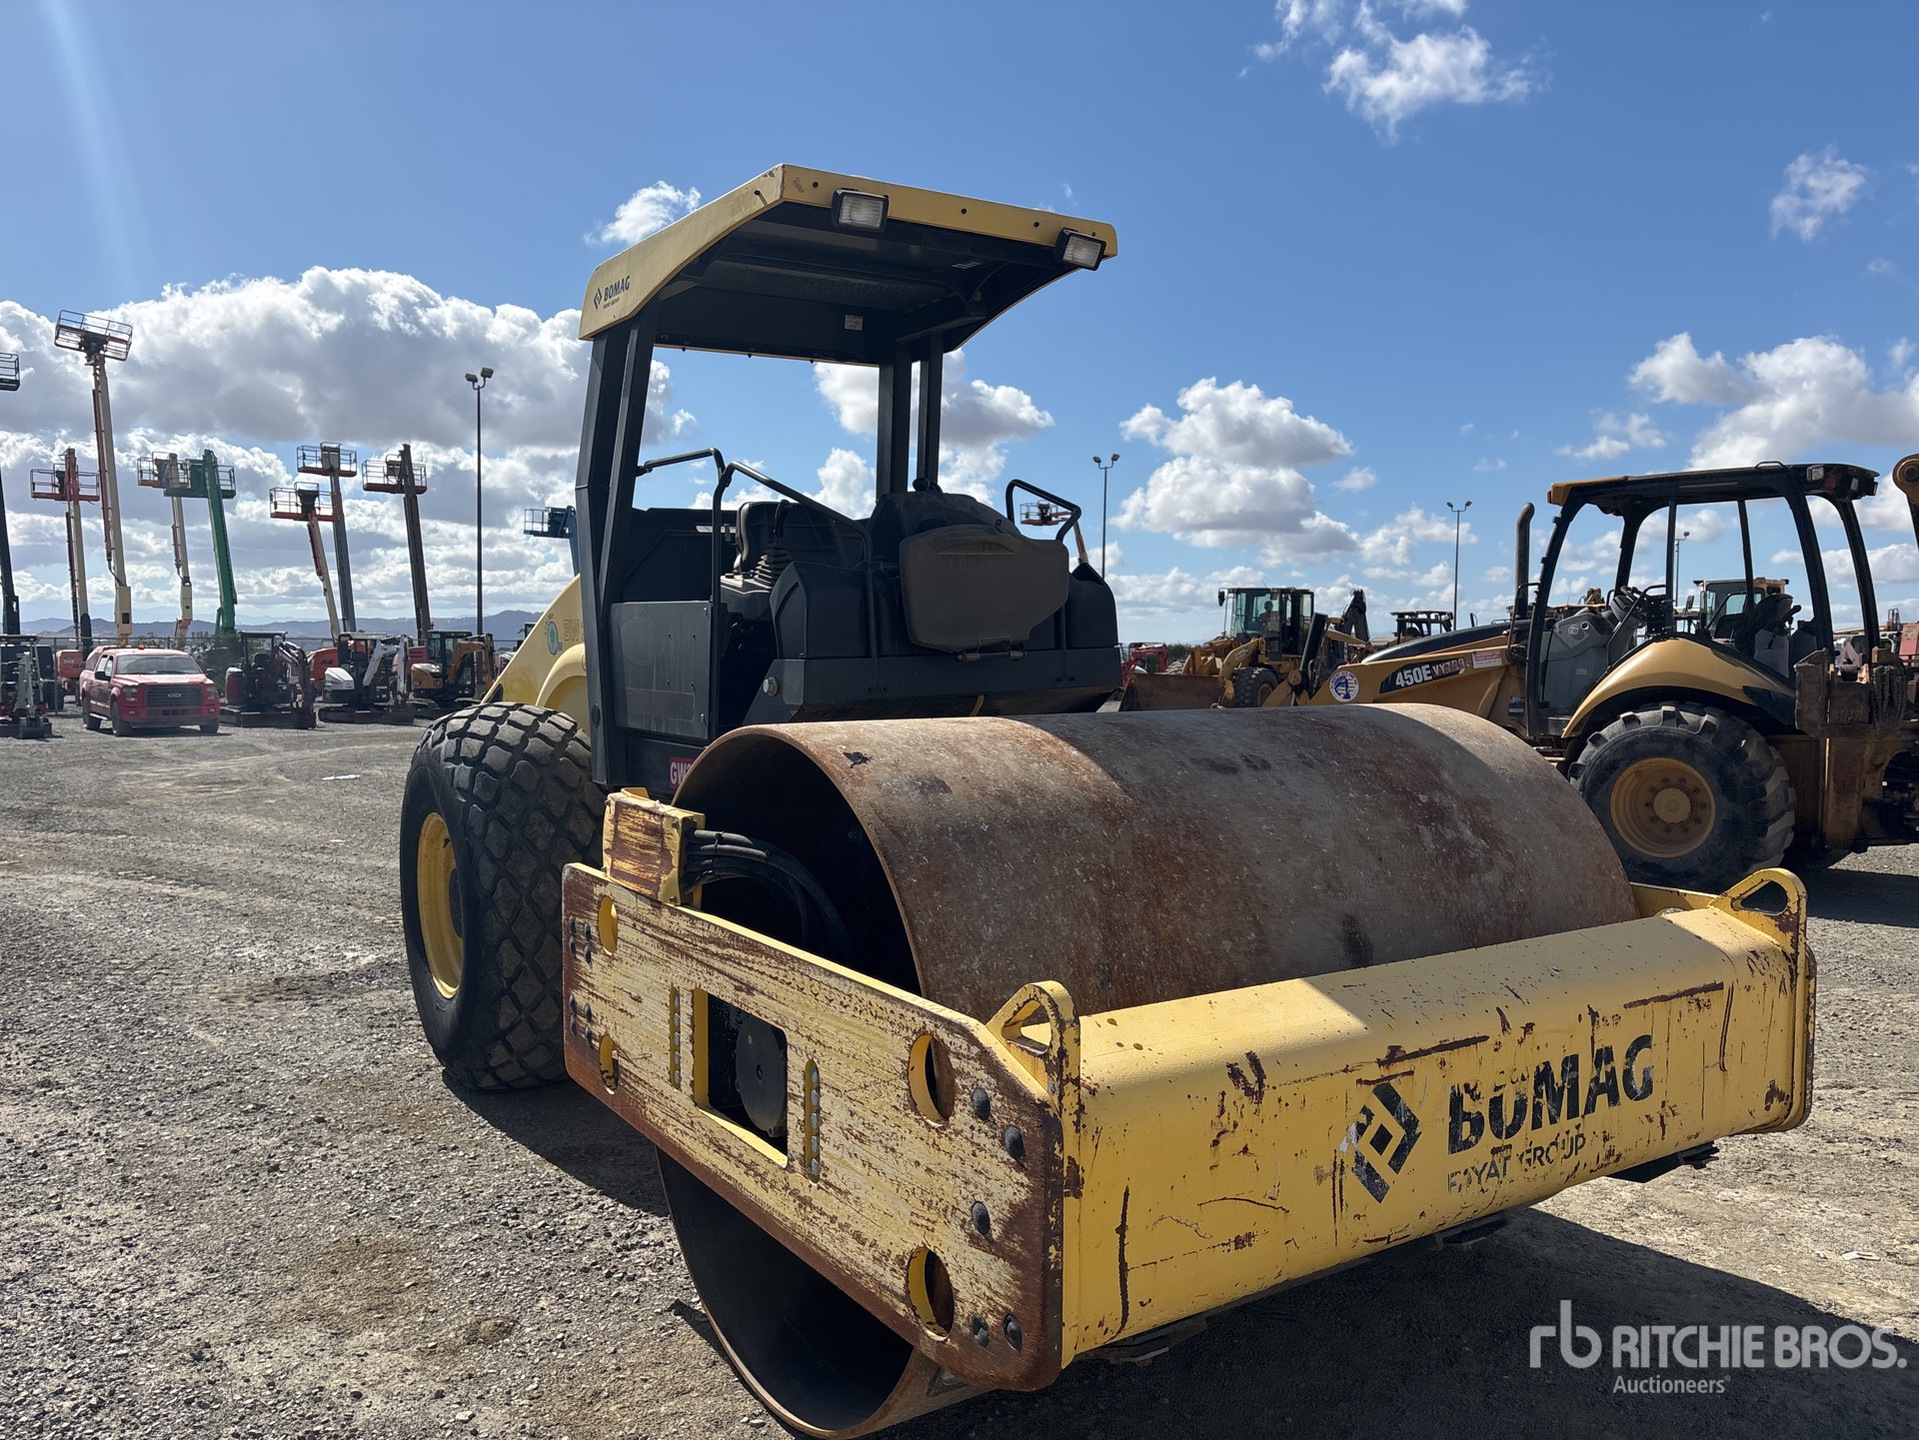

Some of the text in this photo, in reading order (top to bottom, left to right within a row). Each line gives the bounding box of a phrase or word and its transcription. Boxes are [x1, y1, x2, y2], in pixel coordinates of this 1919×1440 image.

[604, 275, 631, 301] BOMAG
[1395, 664, 1433, 687] 450E
[1447, 1034, 1654, 1155] BOMAG
